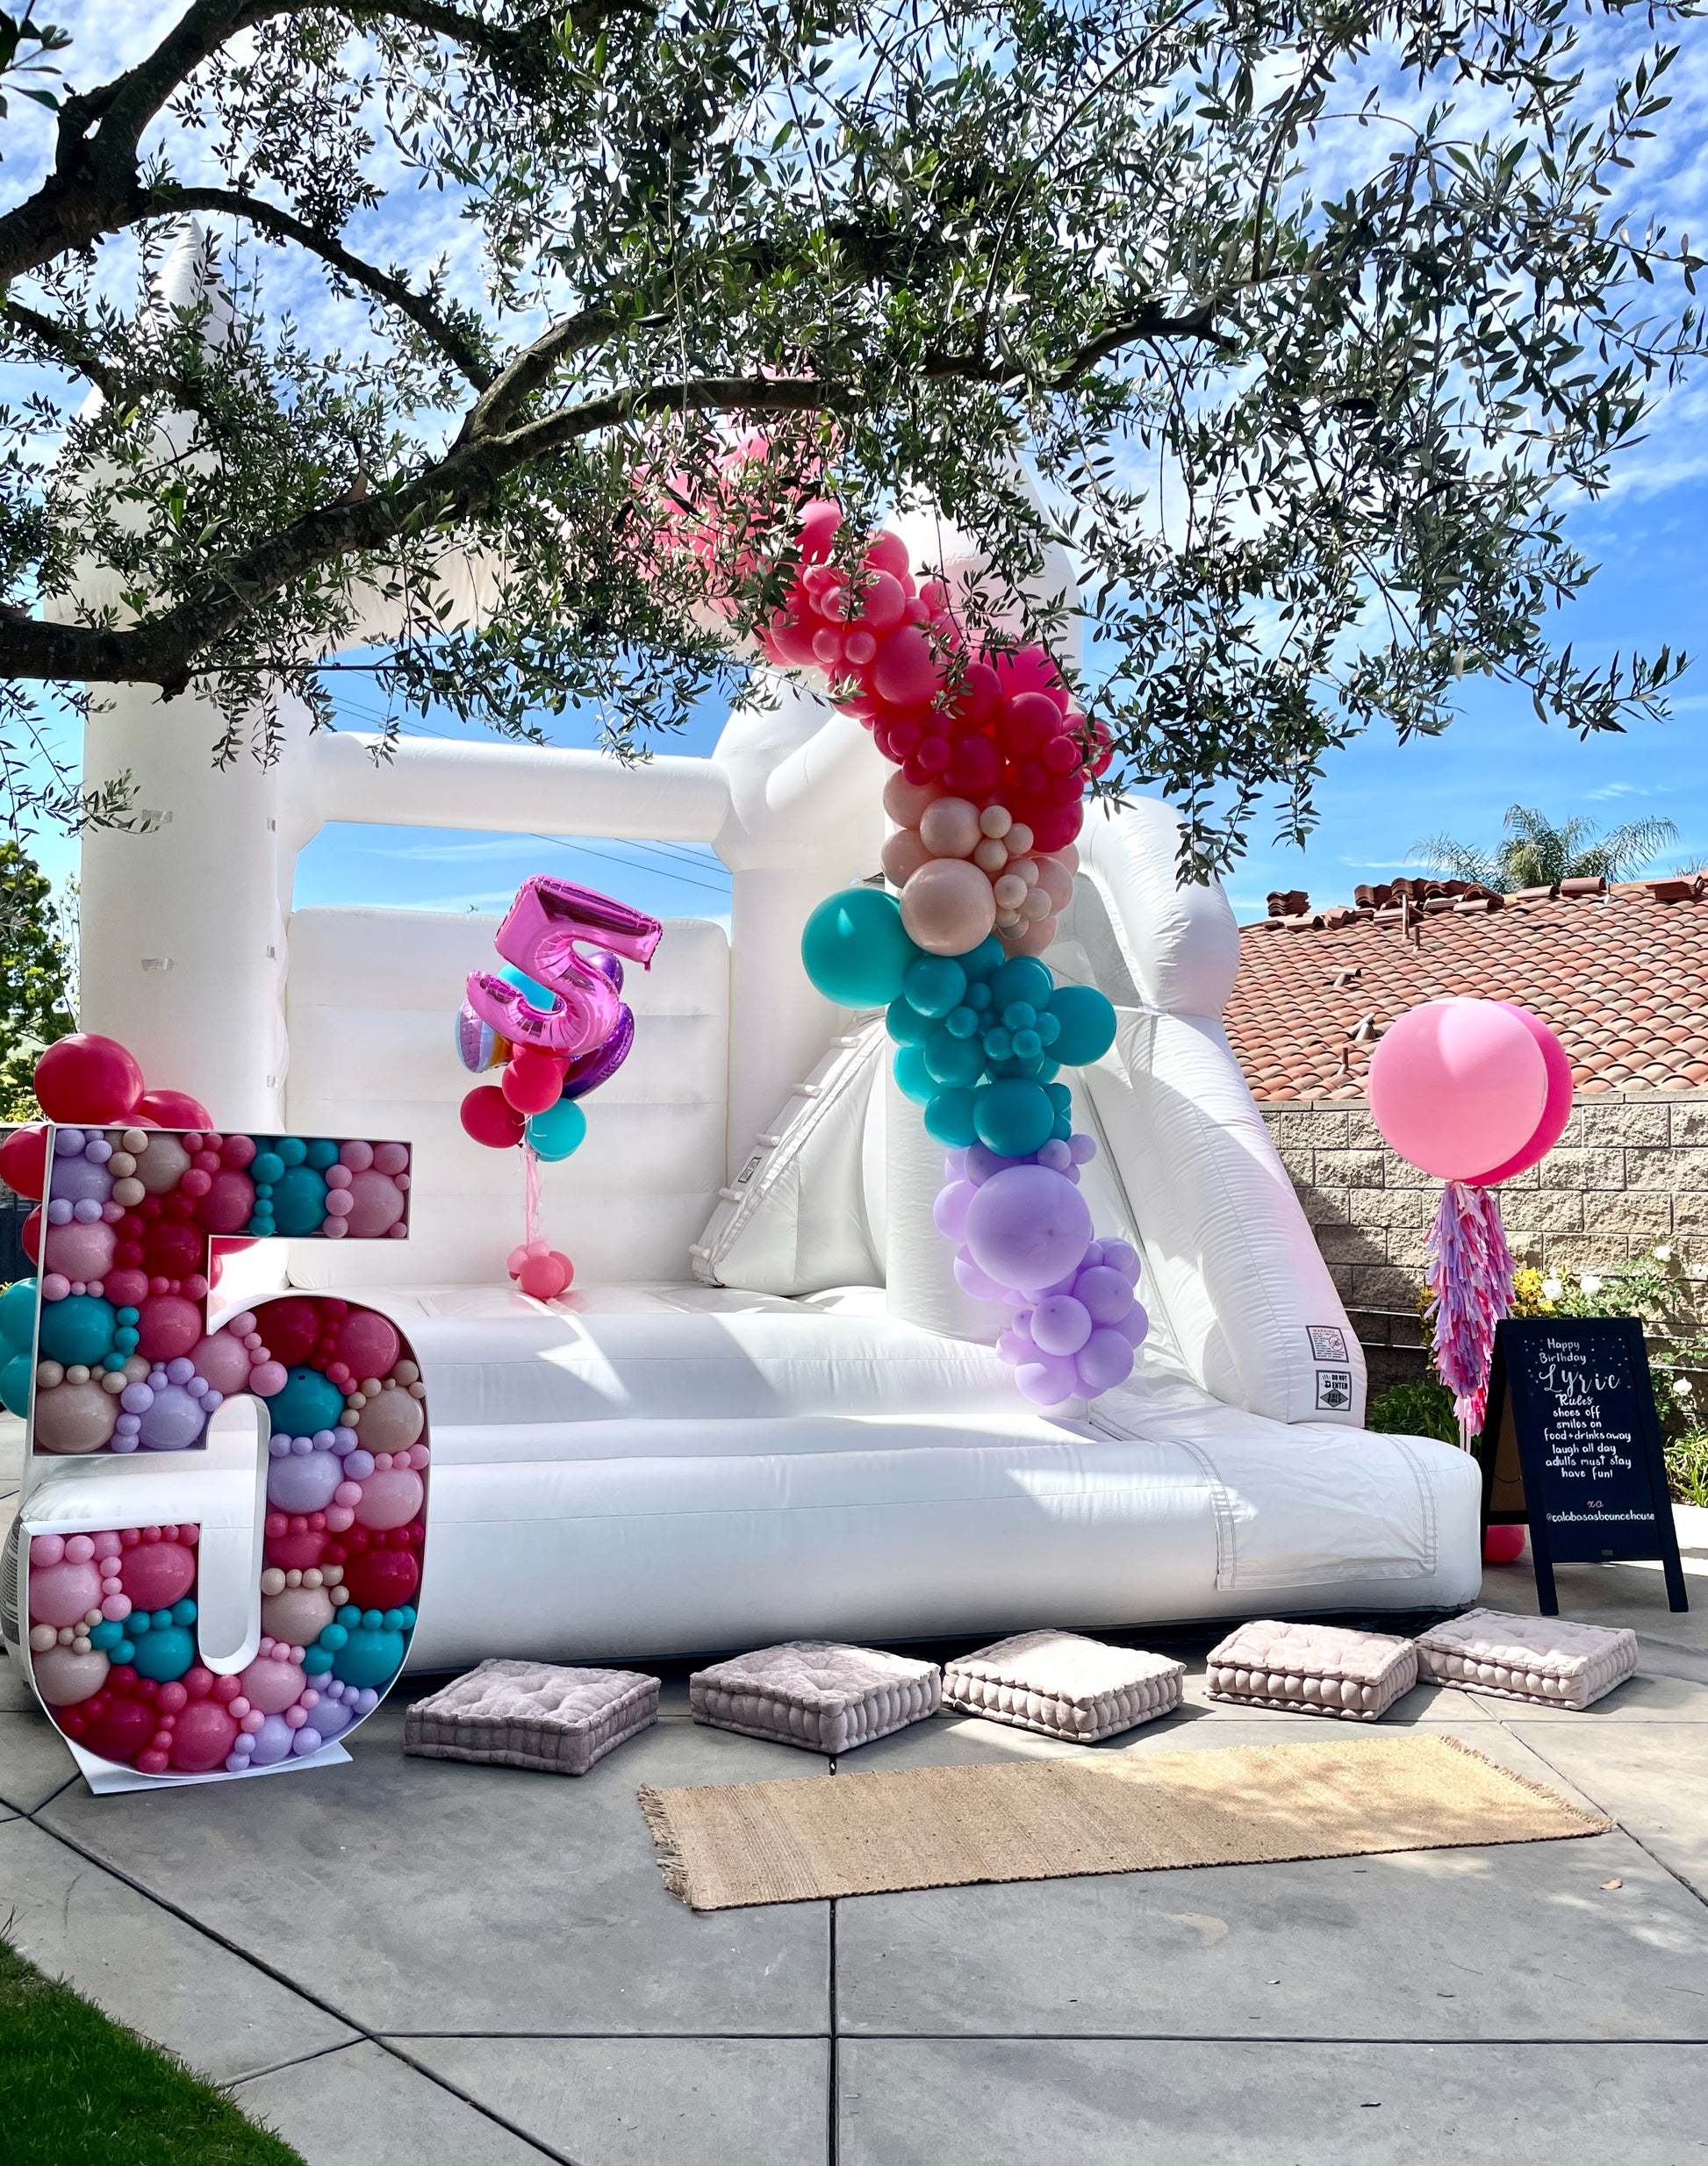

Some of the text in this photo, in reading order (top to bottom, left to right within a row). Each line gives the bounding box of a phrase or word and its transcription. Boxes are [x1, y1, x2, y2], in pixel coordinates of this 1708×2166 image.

[467, 874, 664, 1058] 5
[1547, 1338, 1580, 1352] Happy
[1539, 1352, 1587, 1364] Birthday
[1539, 1364, 1620, 1397] Lyric
[1555, 1394, 1594, 1406] Rules
[1553, 1405, 1601, 1419] shoes off
[1556, 1418, 1587, 1429] smiles
[1605, 1432, 1632, 1442] away
[19, 1123, 431, 1780] 5
[1552, 1442, 1617, 1456] laugh all day
[1546, 1454, 1632, 1469] adults must stay
[1561, 1467, 1586, 1478] have
[1546, 1510, 1655, 1522] @calabasasbouncehouse
